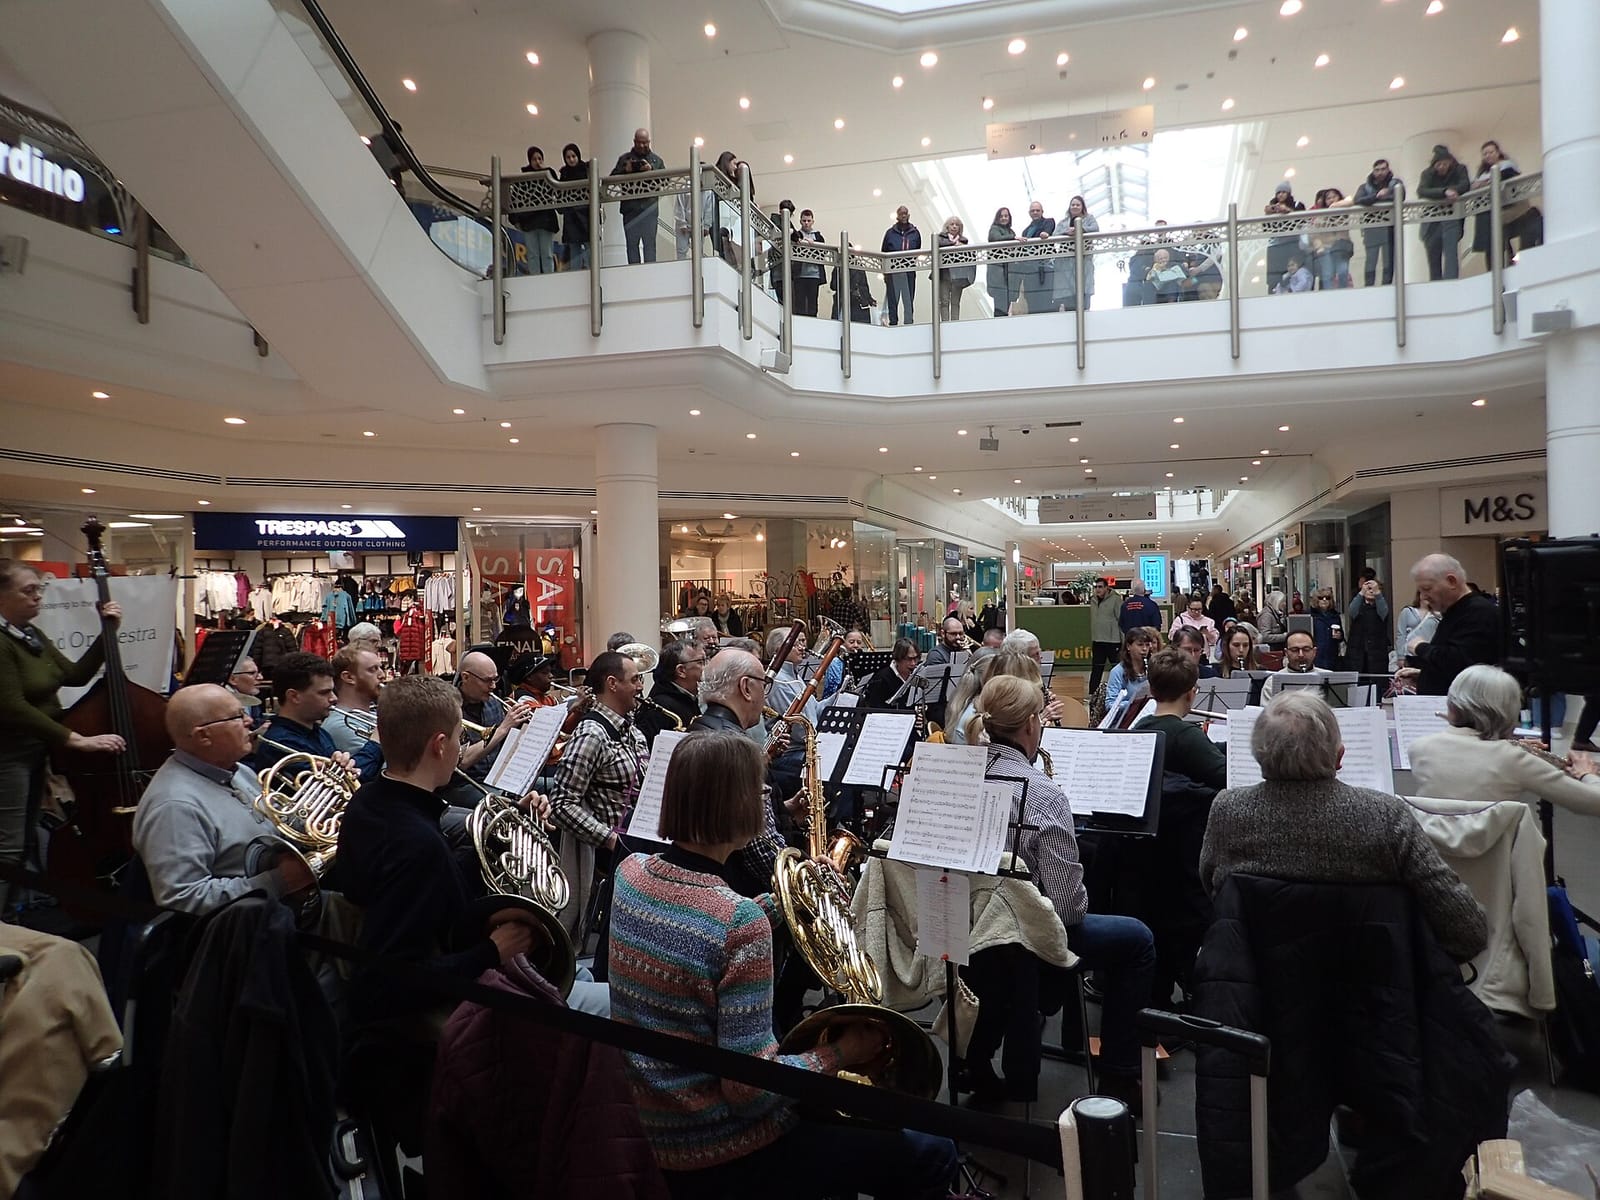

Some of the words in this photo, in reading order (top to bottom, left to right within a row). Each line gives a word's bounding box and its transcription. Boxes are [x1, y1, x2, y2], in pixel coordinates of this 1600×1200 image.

[1464, 493, 1535, 524] M&S
[255, 520, 354, 536] TRESPASS
[537, 556, 564, 645] SALE
[70, 628, 156, 648] Orestra
